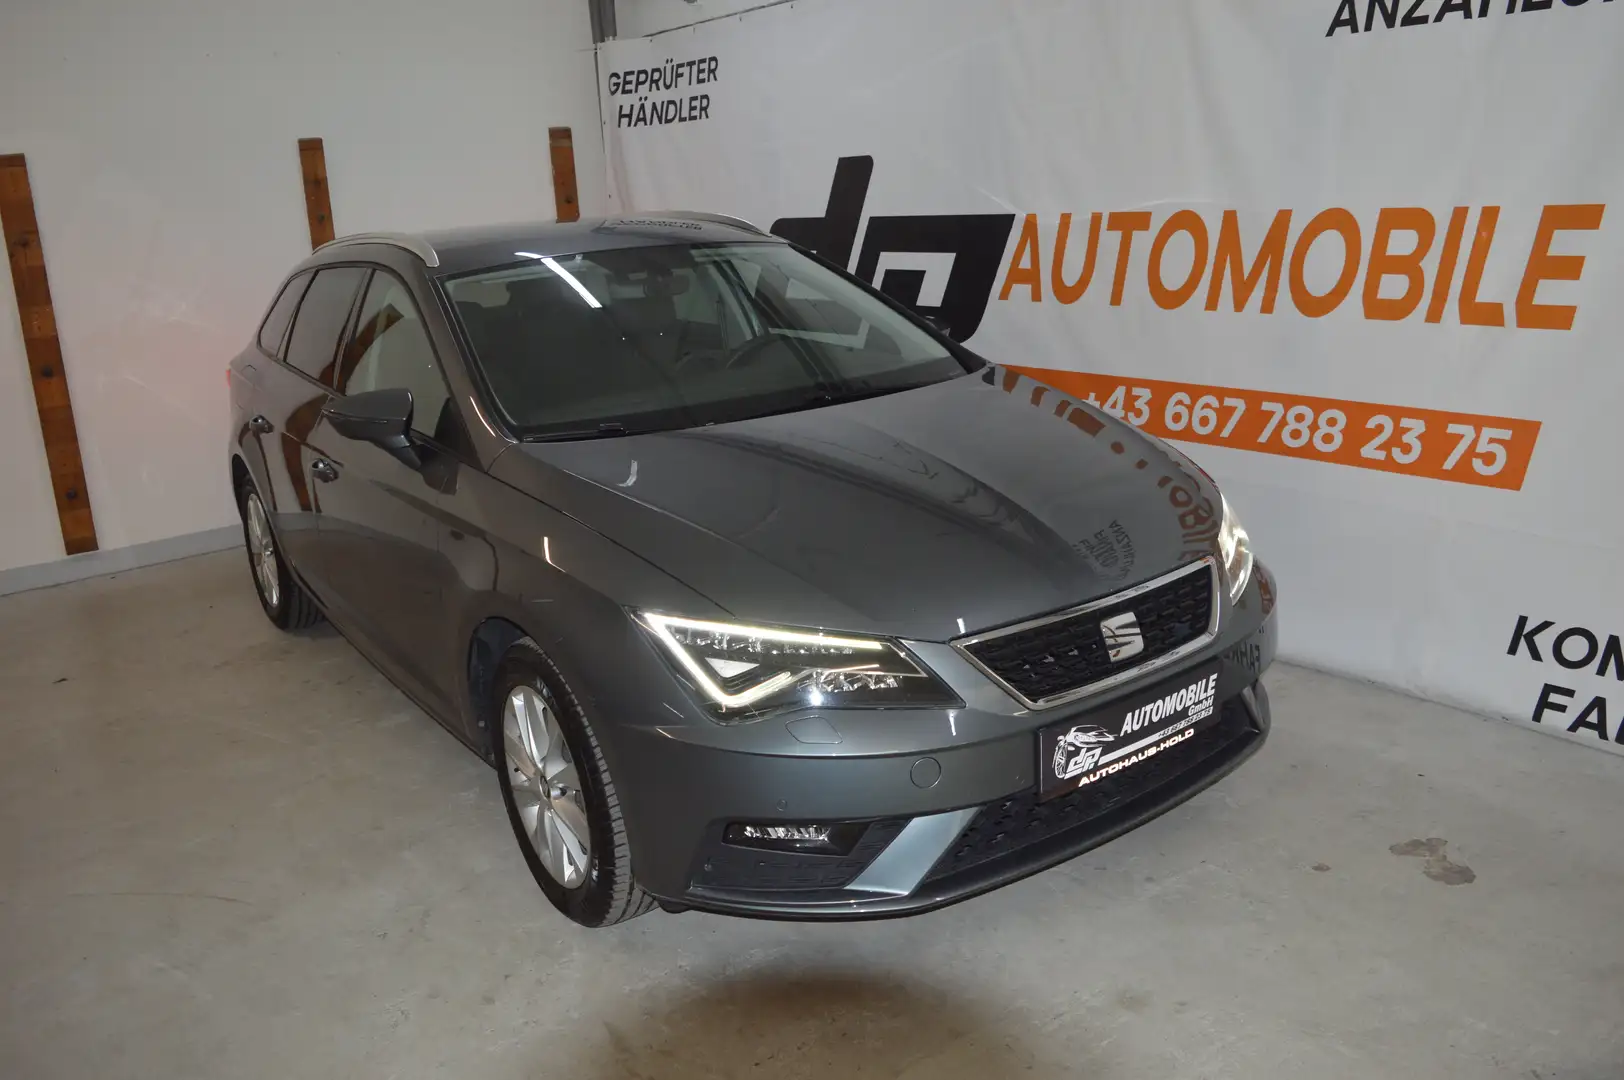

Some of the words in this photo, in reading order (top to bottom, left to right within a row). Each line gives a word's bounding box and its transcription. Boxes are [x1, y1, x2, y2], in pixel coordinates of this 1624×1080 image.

[608, 55, 719, 97] GEPRÜFTER
[617, 94, 710, 128] HÄNDLER
[998, 204, 1605, 330] AUTOMOBILE
[1164, 391, 1246, 438] 667
[1256, 402, 1346, 452] 788
[1360, 415, 1427, 464] 23
[1441, 424, 1512, 476] 75
[1120, 673, 1217, 737] AUTOMOBILE
[1188, 695, 1214, 716] GmbH
[1532, 683, 1624, 745] FA
[1078, 728, 1194, 787] AUTOHAUS-HOLD
